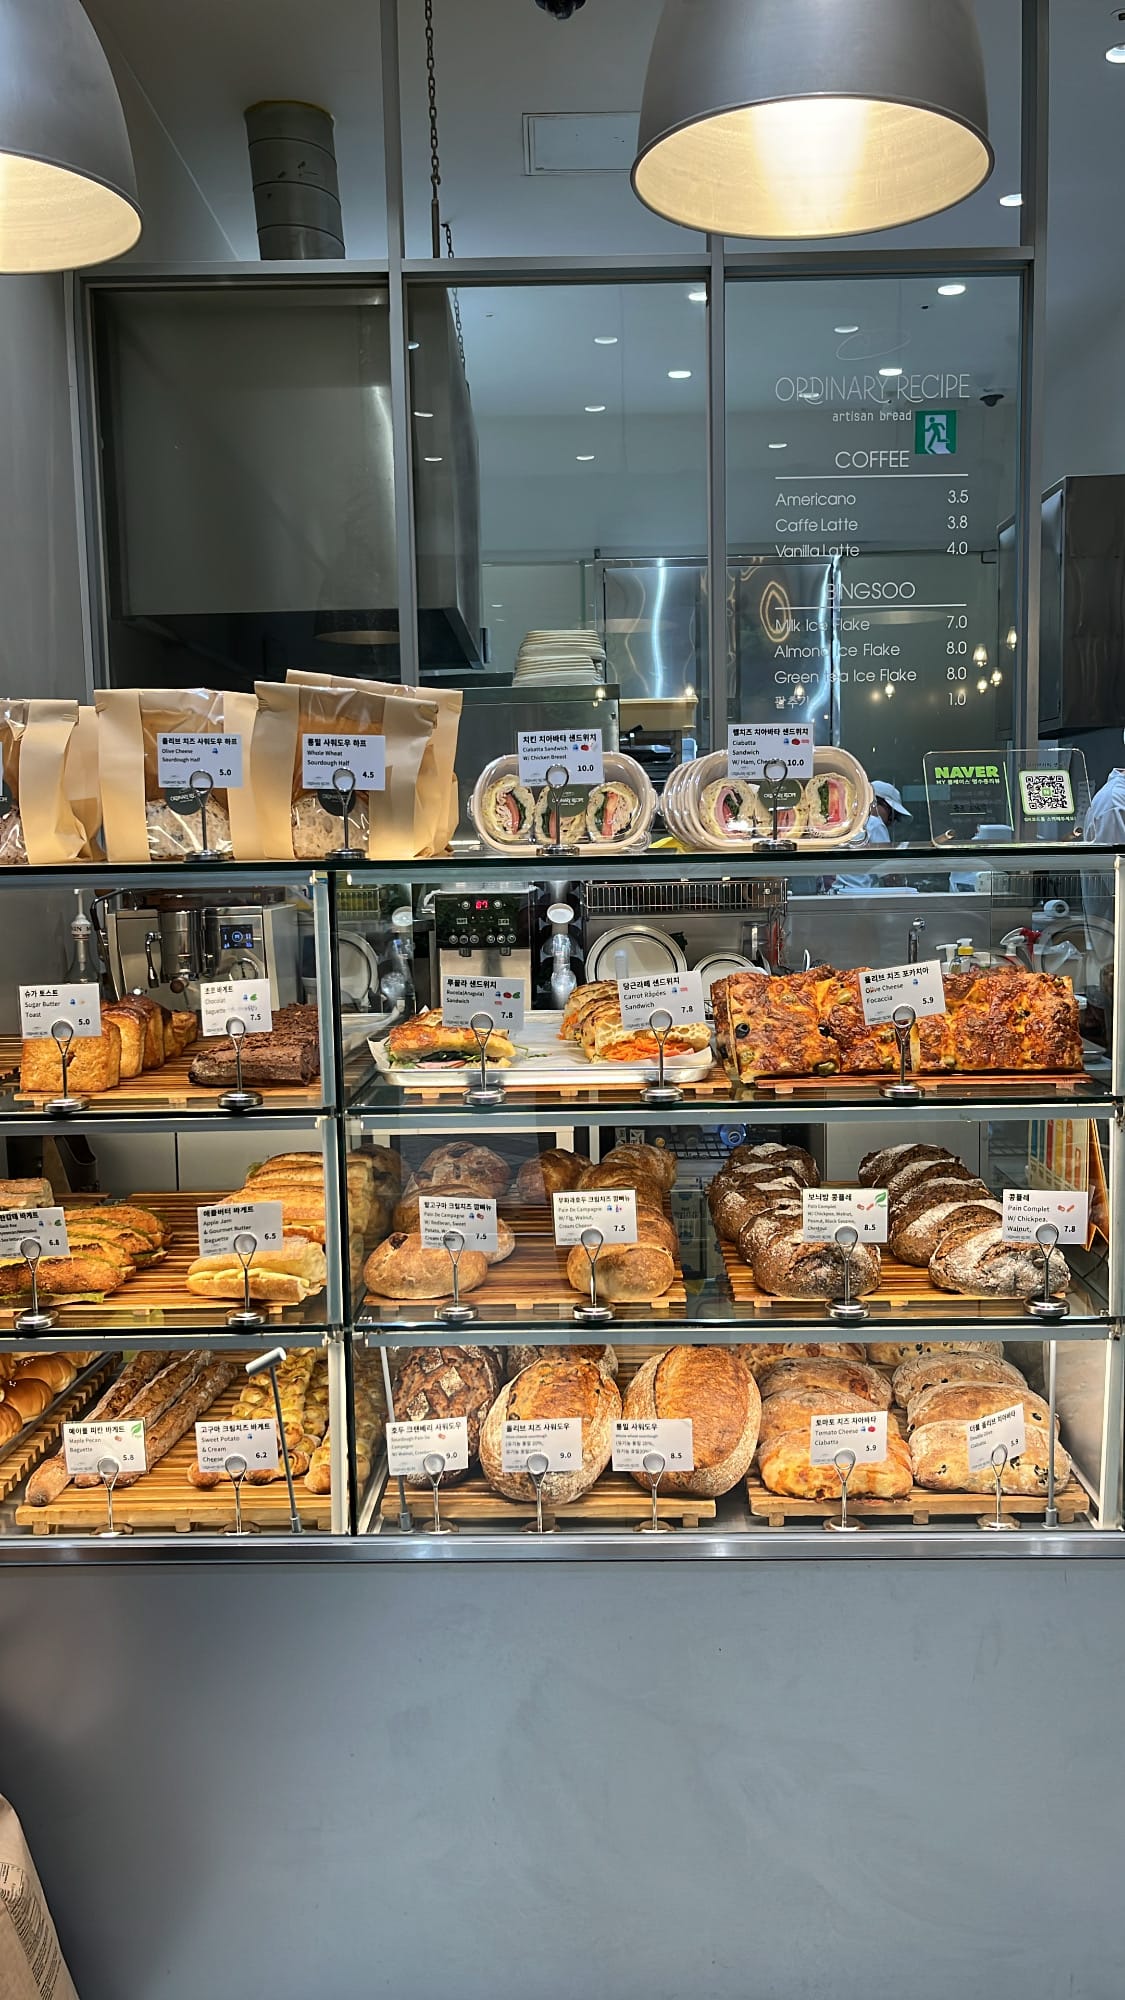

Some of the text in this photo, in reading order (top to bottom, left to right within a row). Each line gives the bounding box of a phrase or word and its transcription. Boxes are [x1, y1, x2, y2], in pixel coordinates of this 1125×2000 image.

[775, 373, 971, 405] ORDINARY RECIPE
[832, 409, 912, 422] artisan bread
[835, 450, 910, 469] COFFEE
[775, 492, 856, 507] Americano
[947, 489, 969, 504] 3.5
[775, 518, 858, 533] Caffe Latte
[947, 515, 968, 530] 3.8
[775, 543, 860, 559] Vanilla Latte
[946, 541, 968, 555] 4.0
[775, 618, 870, 632] Milk Ice Flake
[946, 615, 968, 629] 7.0
[863, 643, 900, 656] Flake
[946, 641, 967, 655] 8.0
[774, 671, 819, 684] Green
[853, 669, 875, 682] Ice
[880, 668, 917, 681] Flake
[946, 666, 967, 680] 8.0
[948, 692, 966, 706] 1.0
[754, 728, 780, 736] 치아바타
[782, 728, 809, 736] 샌드위치
[162, 737, 181, 745] 올리브
[323, 738, 351, 747] 사워도우
[353, 739, 367, 747] 하프
[523, 733, 597, 744] 치킨 치아바타 샌드위치
[219, 768, 232, 776] 5.0
[577, 764, 594, 772] 10.0
[934, 766, 999, 779] NAVER
[864, 966, 929, 984] 올리브 치즈 포카치아
[469, 980, 497, 989] 샌드위치
[623, 977, 680, 990] 당근라페 샌드위치
[881, 983, 904, 991] Cheese
[25, 989, 58, 998] 슈가 토스트
[866, 995, 893, 1004] Focaccia
[922, 996, 934, 1005] 5.9
[624, 1002, 655, 1010] Sandwich
[681, 1005, 694, 1013] 7.8
[501, 1011, 513, 1019] 7.8
[78, 1018, 90, 1026] 5.0
[233, 1205, 255, 1214] 바게트
[1023, 1205, 1050, 1213] Complet
[1064, 1225, 1076, 1233] 7.8
[264, 1232, 276, 1240] 6.5
[852, 1416, 877, 1424] 치아바타
[105, 1426, 126, 1434] 바게트
[201, 1423, 271, 1434] 고구마 크림치즈 바게트
[528, 1424, 542, 1432] 치즈
[543, 1423, 570, 1431] 사워도우
[631, 1423, 658, 1431] 사워도우
[865, 1444, 877, 1452] 5.9
[255, 1451, 267, 1459] 6.2
[560, 1451, 572, 1459] 9.0
